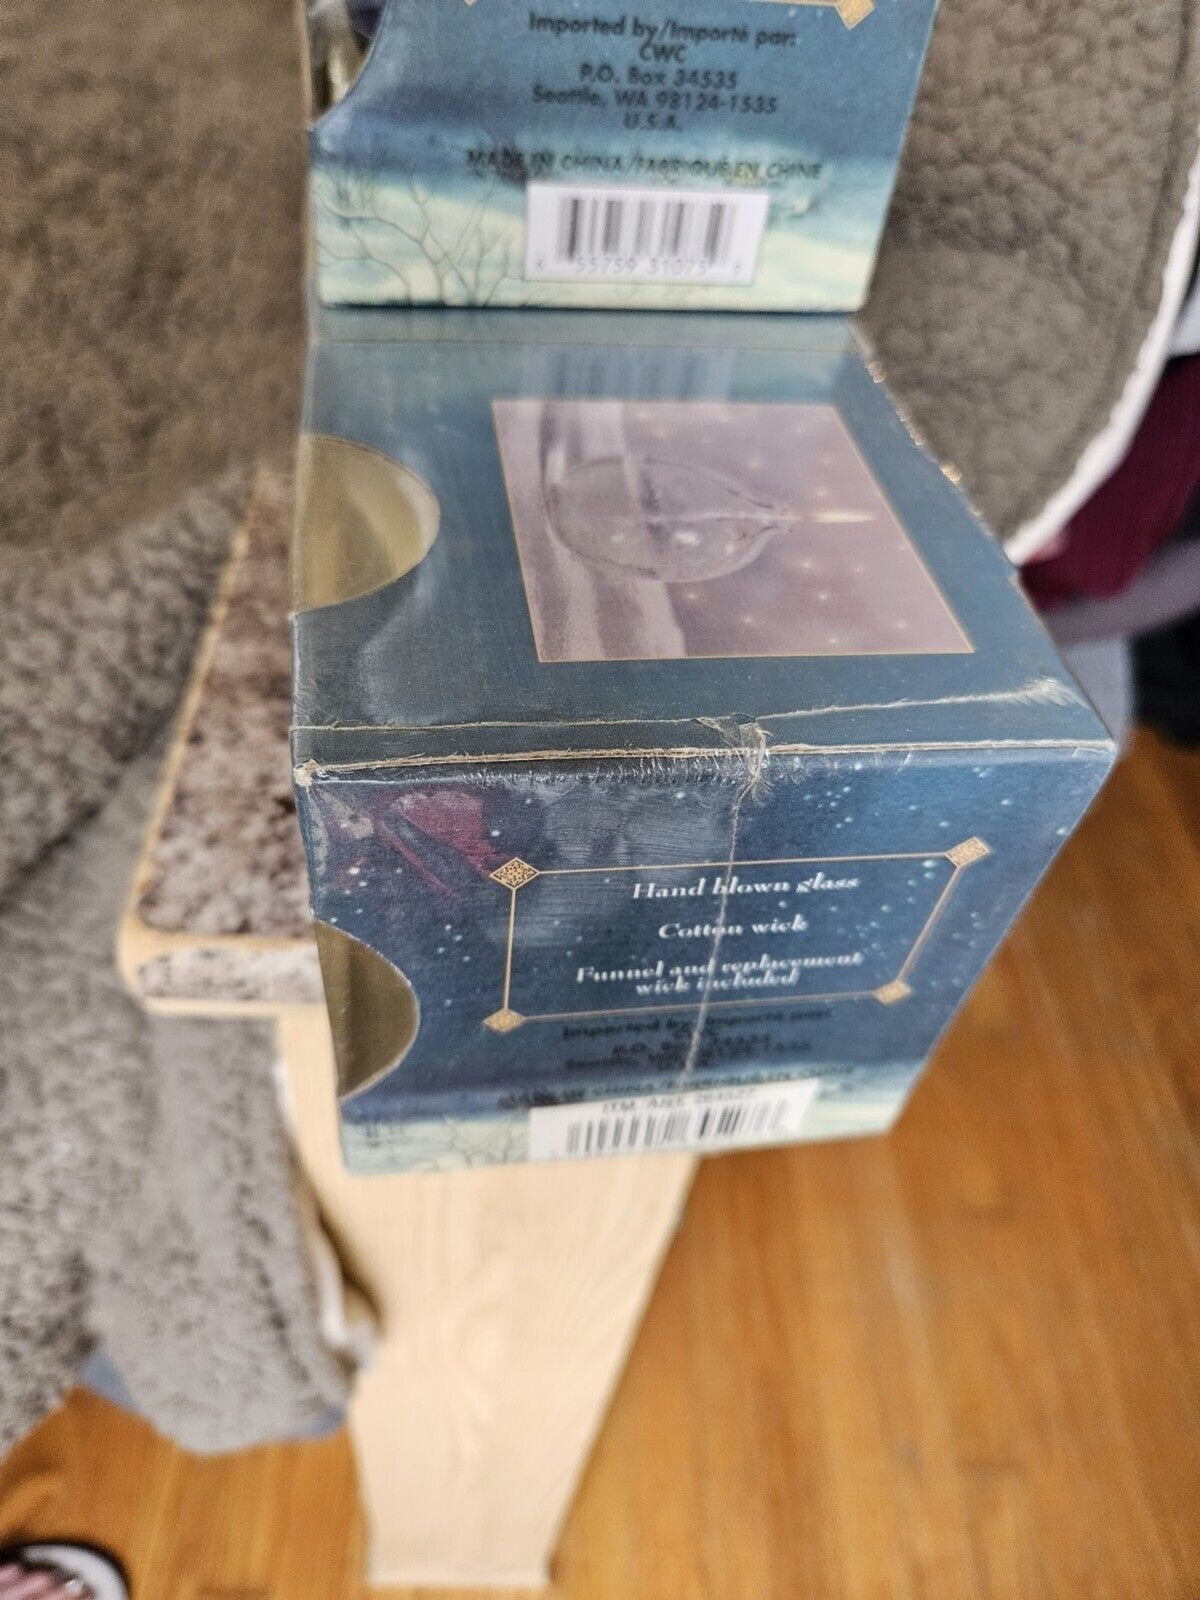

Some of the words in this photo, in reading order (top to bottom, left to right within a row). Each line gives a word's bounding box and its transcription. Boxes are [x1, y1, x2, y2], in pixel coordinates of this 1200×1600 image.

[529, 12, 626, 36] Imported
[639, 44, 687, 63] CWC
[627, 66, 666, 86] Box
[614, 88, 648, 108] WA
[633, 876, 704, 899] Hand
[711, 875, 791, 896] blown
[795, 871, 861, 894] glass
[657, 920, 744, 940] Cotton
[750, 914, 809, 934] wick
[576, 959, 665, 982] Funnel
[669, 957, 715, 976] and
[721, 952, 864, 973] replacement
[635, 974, 691, 996] wick
[696, 967, 800, 991] included
